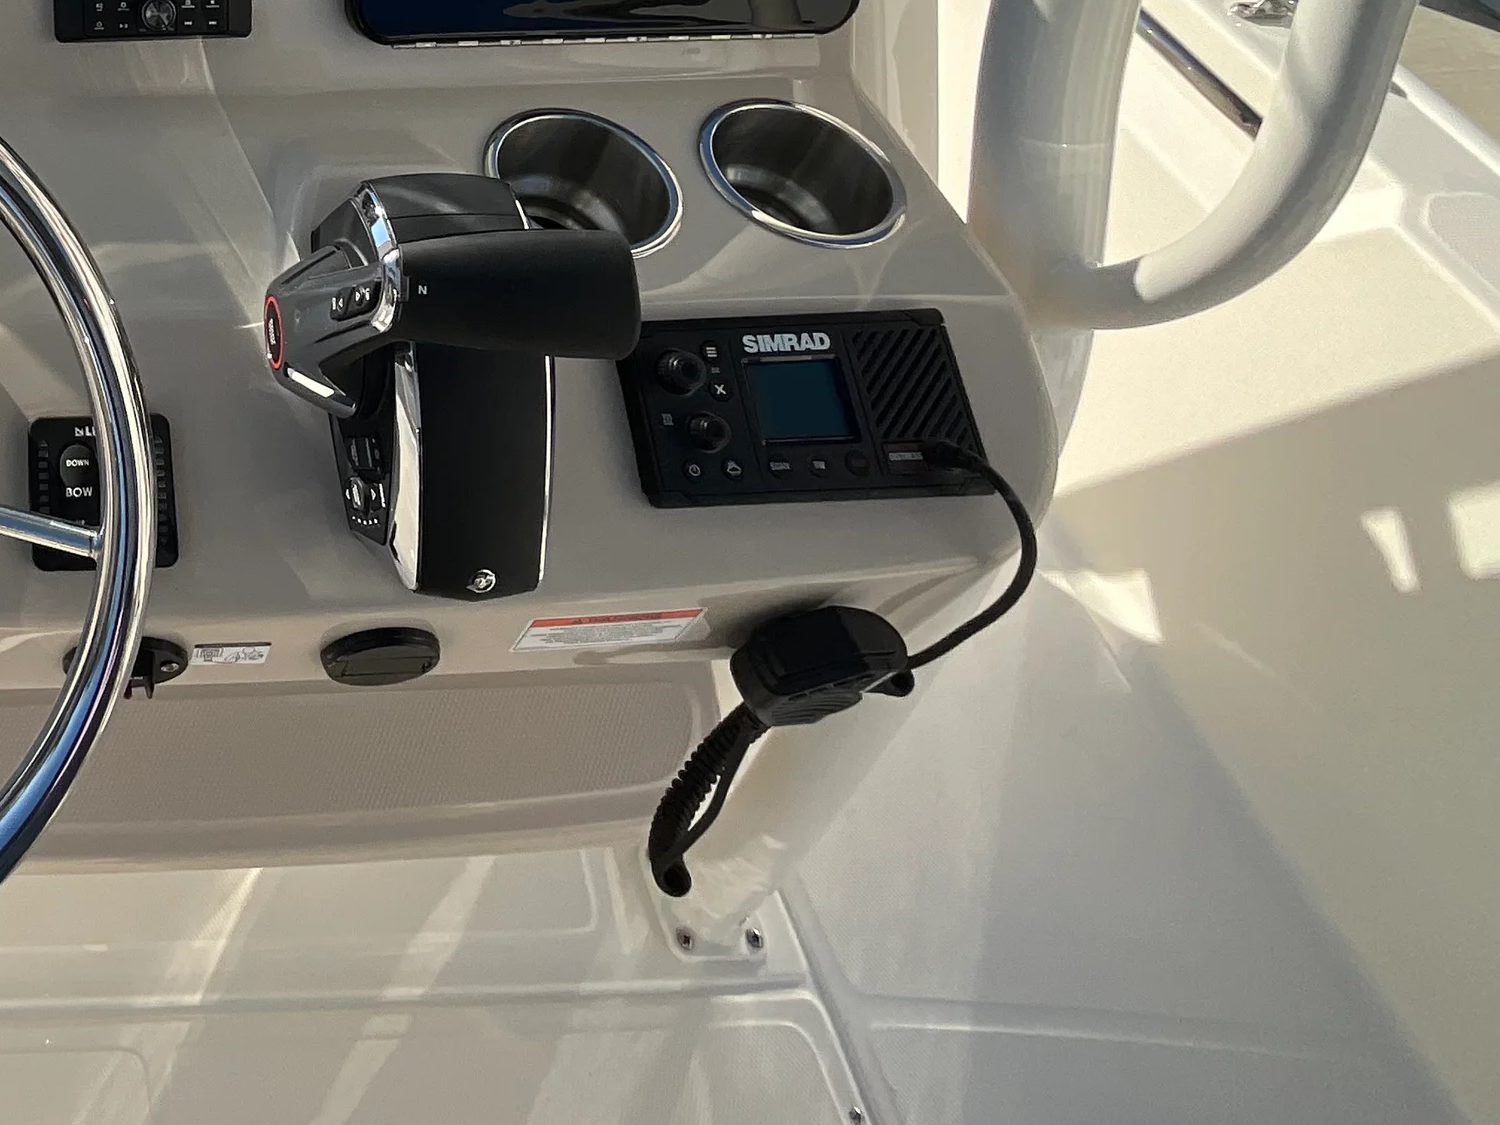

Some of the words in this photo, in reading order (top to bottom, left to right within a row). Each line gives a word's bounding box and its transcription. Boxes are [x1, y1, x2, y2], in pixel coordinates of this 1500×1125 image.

[418, 285, 427, 295] N
[742, 332, 831, 353] SIMRAD
[65, 459, 90, 467] DOWN
[65, 486, 93, 498] BOW
